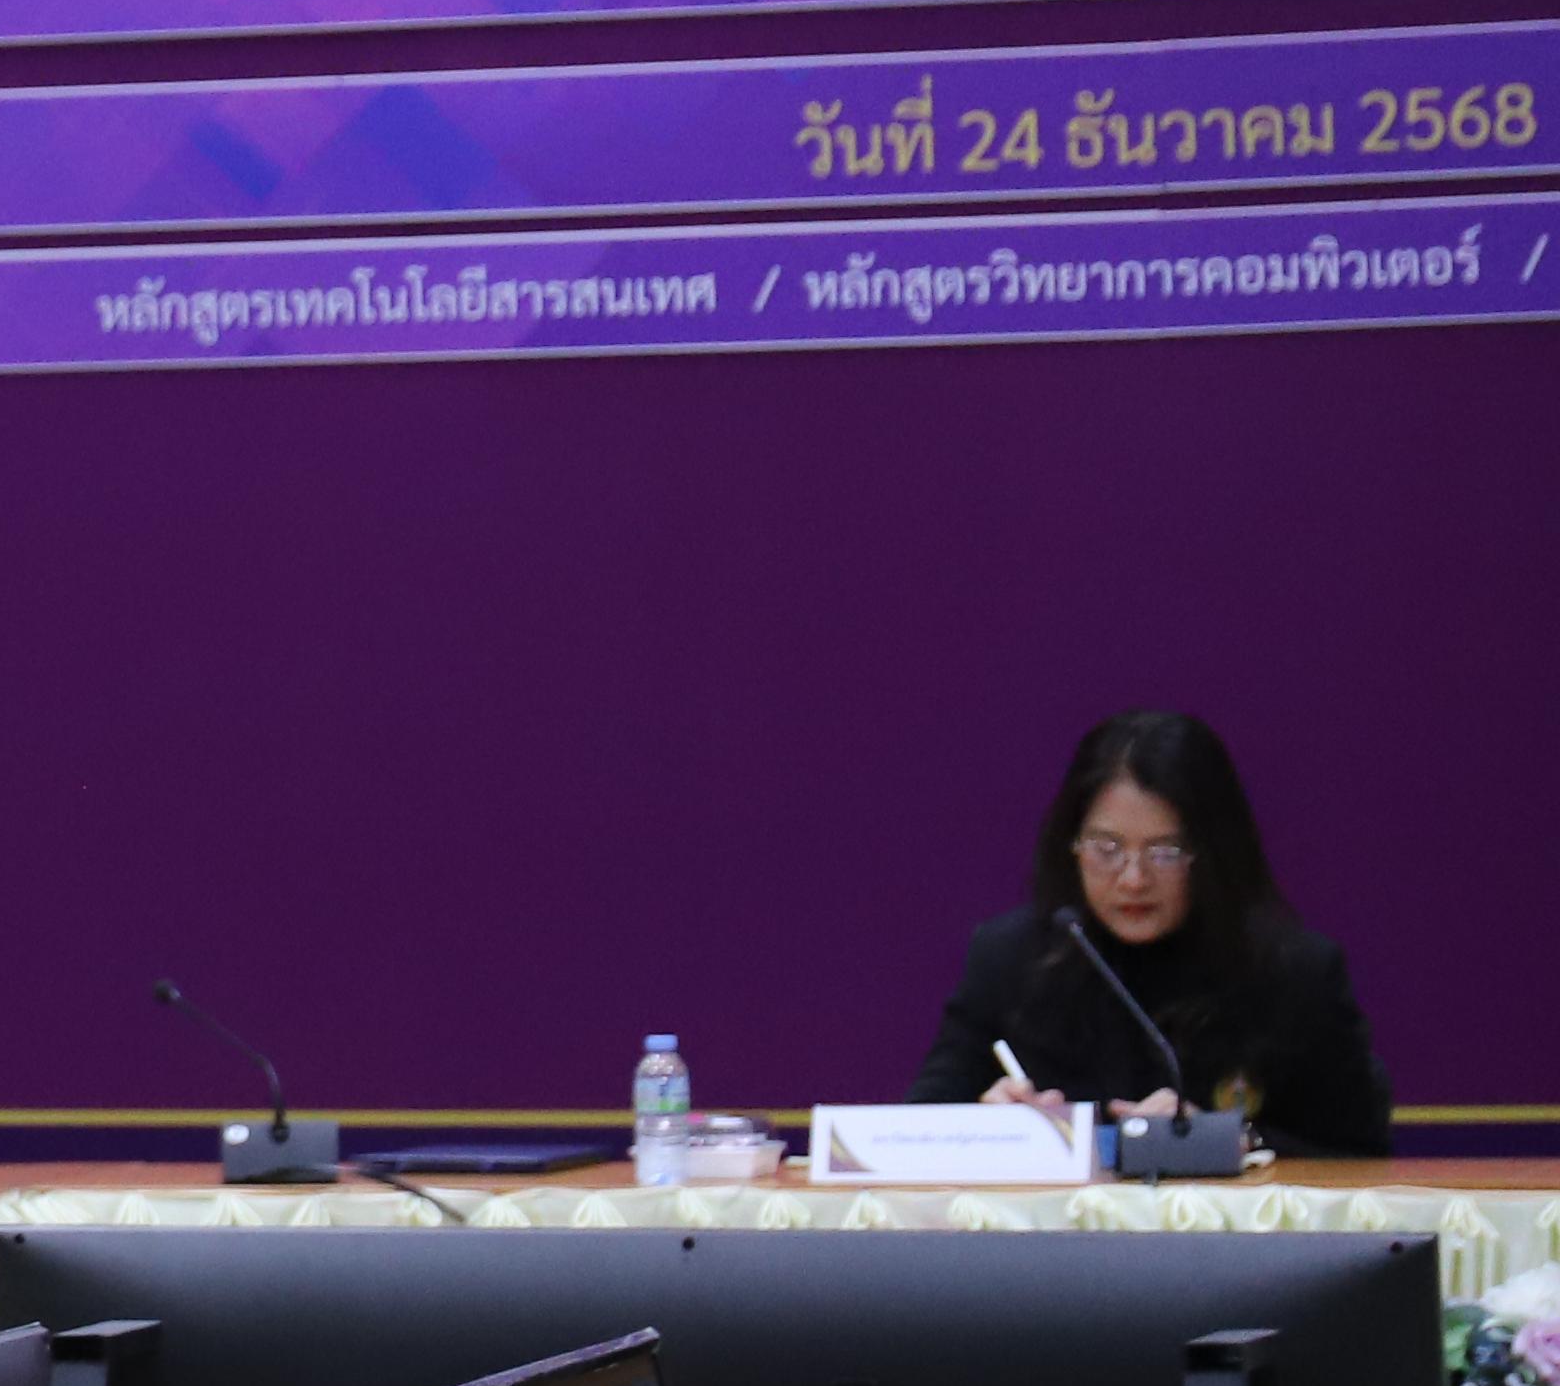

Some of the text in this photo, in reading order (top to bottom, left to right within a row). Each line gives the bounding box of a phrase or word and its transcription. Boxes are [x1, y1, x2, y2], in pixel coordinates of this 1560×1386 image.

[795, 74, 1538, 180] วันที่ 24 ธันวาคม 2568
[96, 263, 717, 347] หลักสูตรเทคโนโลยีสารสนเทศ
[802, 223, 1483, 324] หลักสูตรวิทยาการคอมพิวเตอร์
